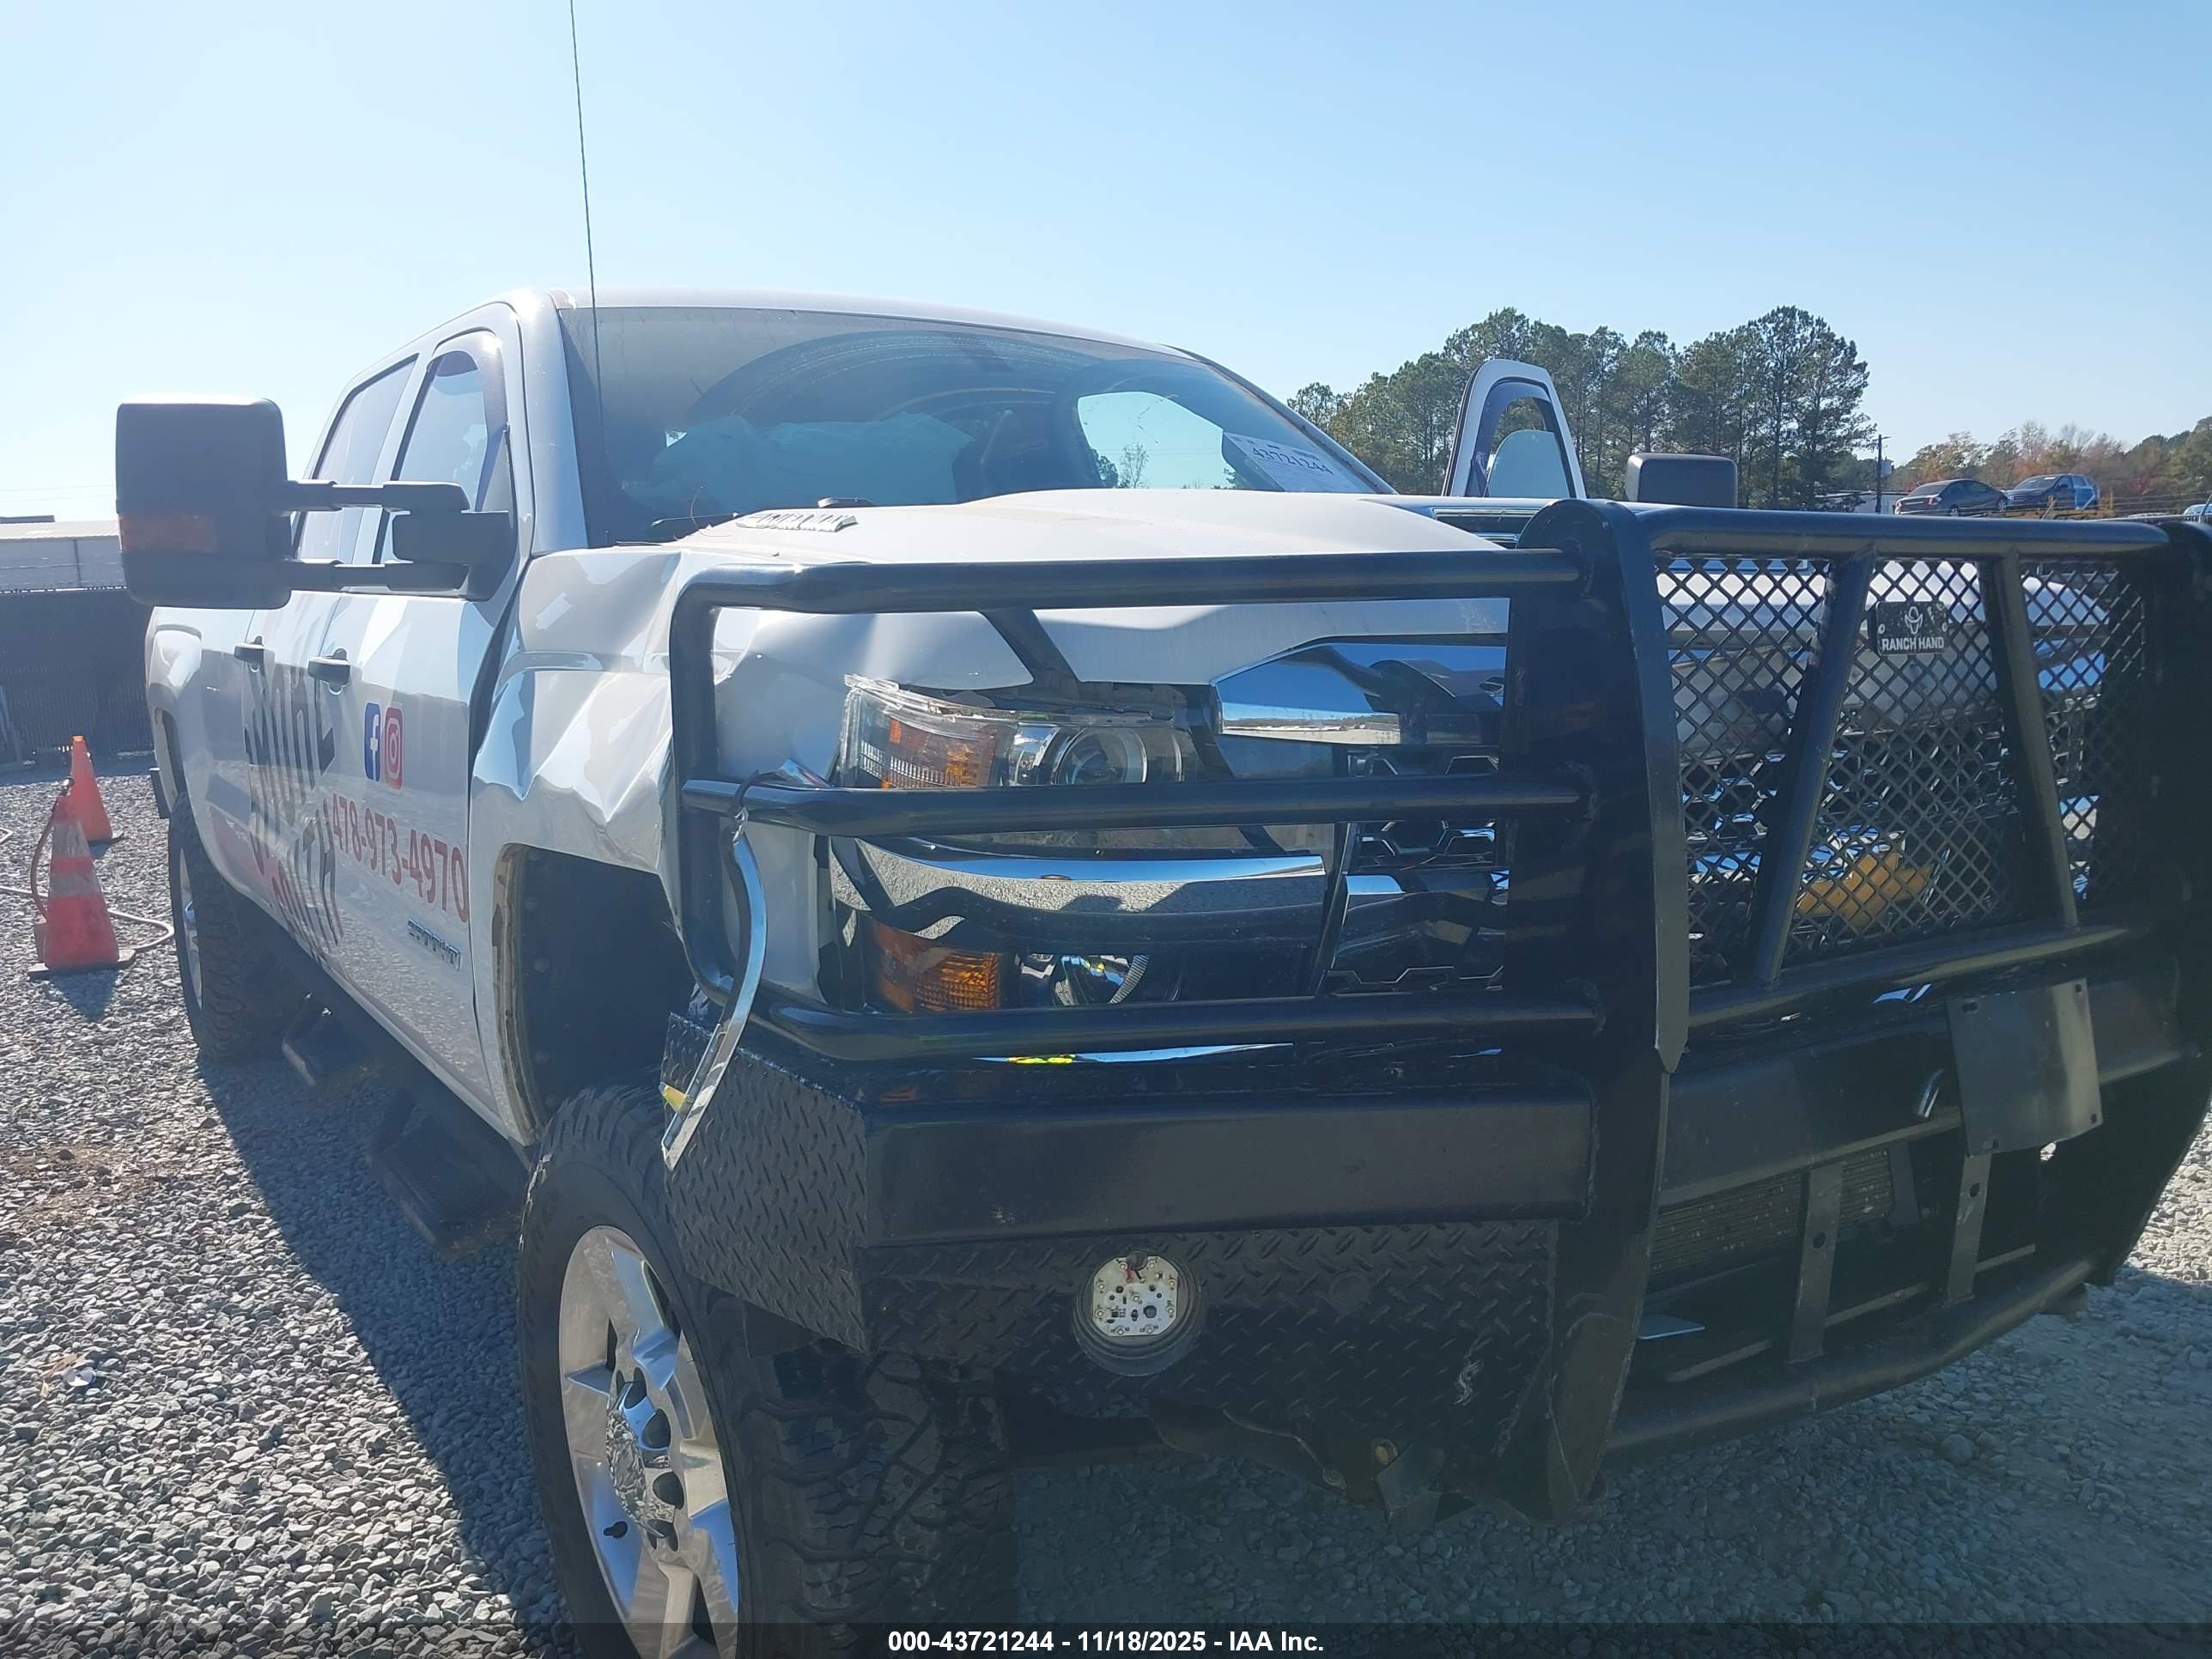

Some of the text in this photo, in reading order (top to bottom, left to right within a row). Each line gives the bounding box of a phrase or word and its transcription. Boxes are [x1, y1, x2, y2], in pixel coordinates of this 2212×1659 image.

[1252, 447, 1334, 475] 43721244
[1881, 636, 1945, 651] RANCH HAND
[331, 793, 470, 923] 478-973-4970
